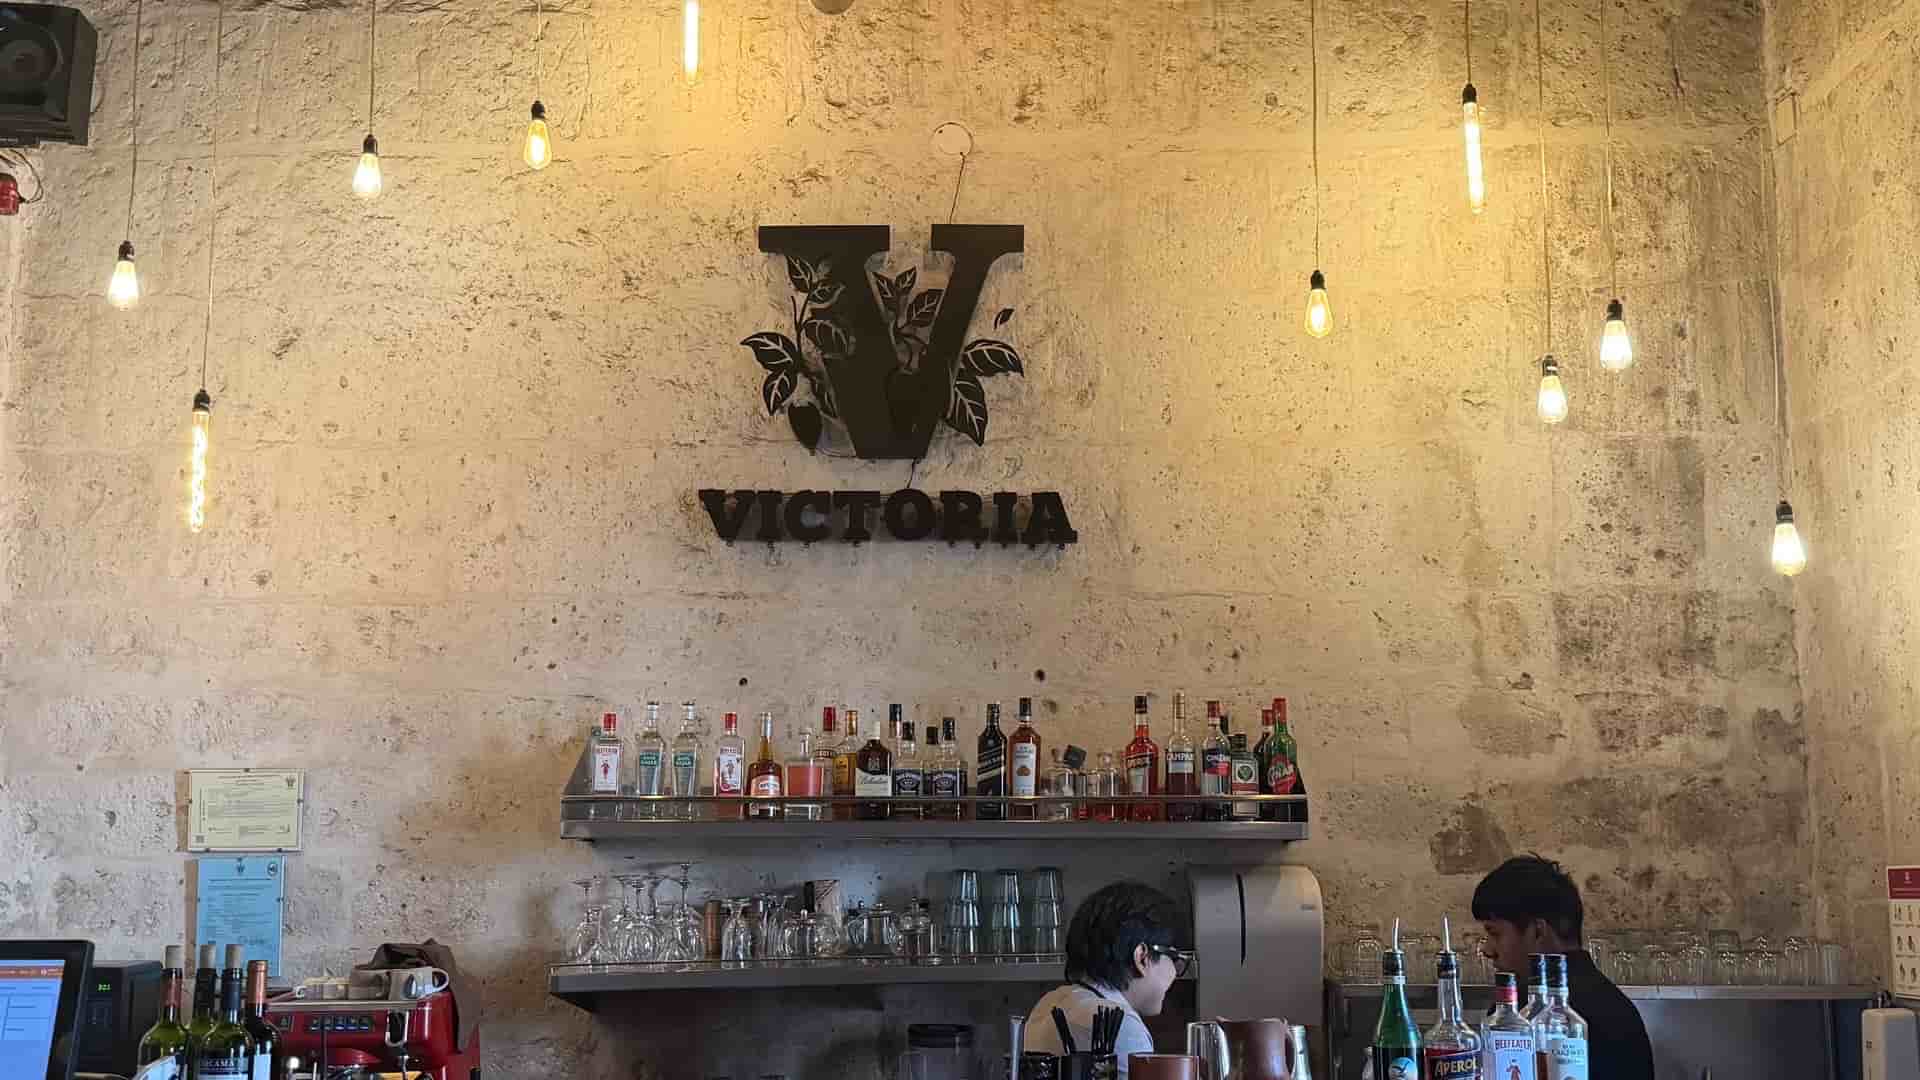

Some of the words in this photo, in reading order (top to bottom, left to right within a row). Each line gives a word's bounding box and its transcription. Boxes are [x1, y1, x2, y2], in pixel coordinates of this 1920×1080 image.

[758, 224, 1024, 459] V
[699, 488, 1078, 545] VICTORIA
[1434, 1056, 1478, 1073] APEROL
